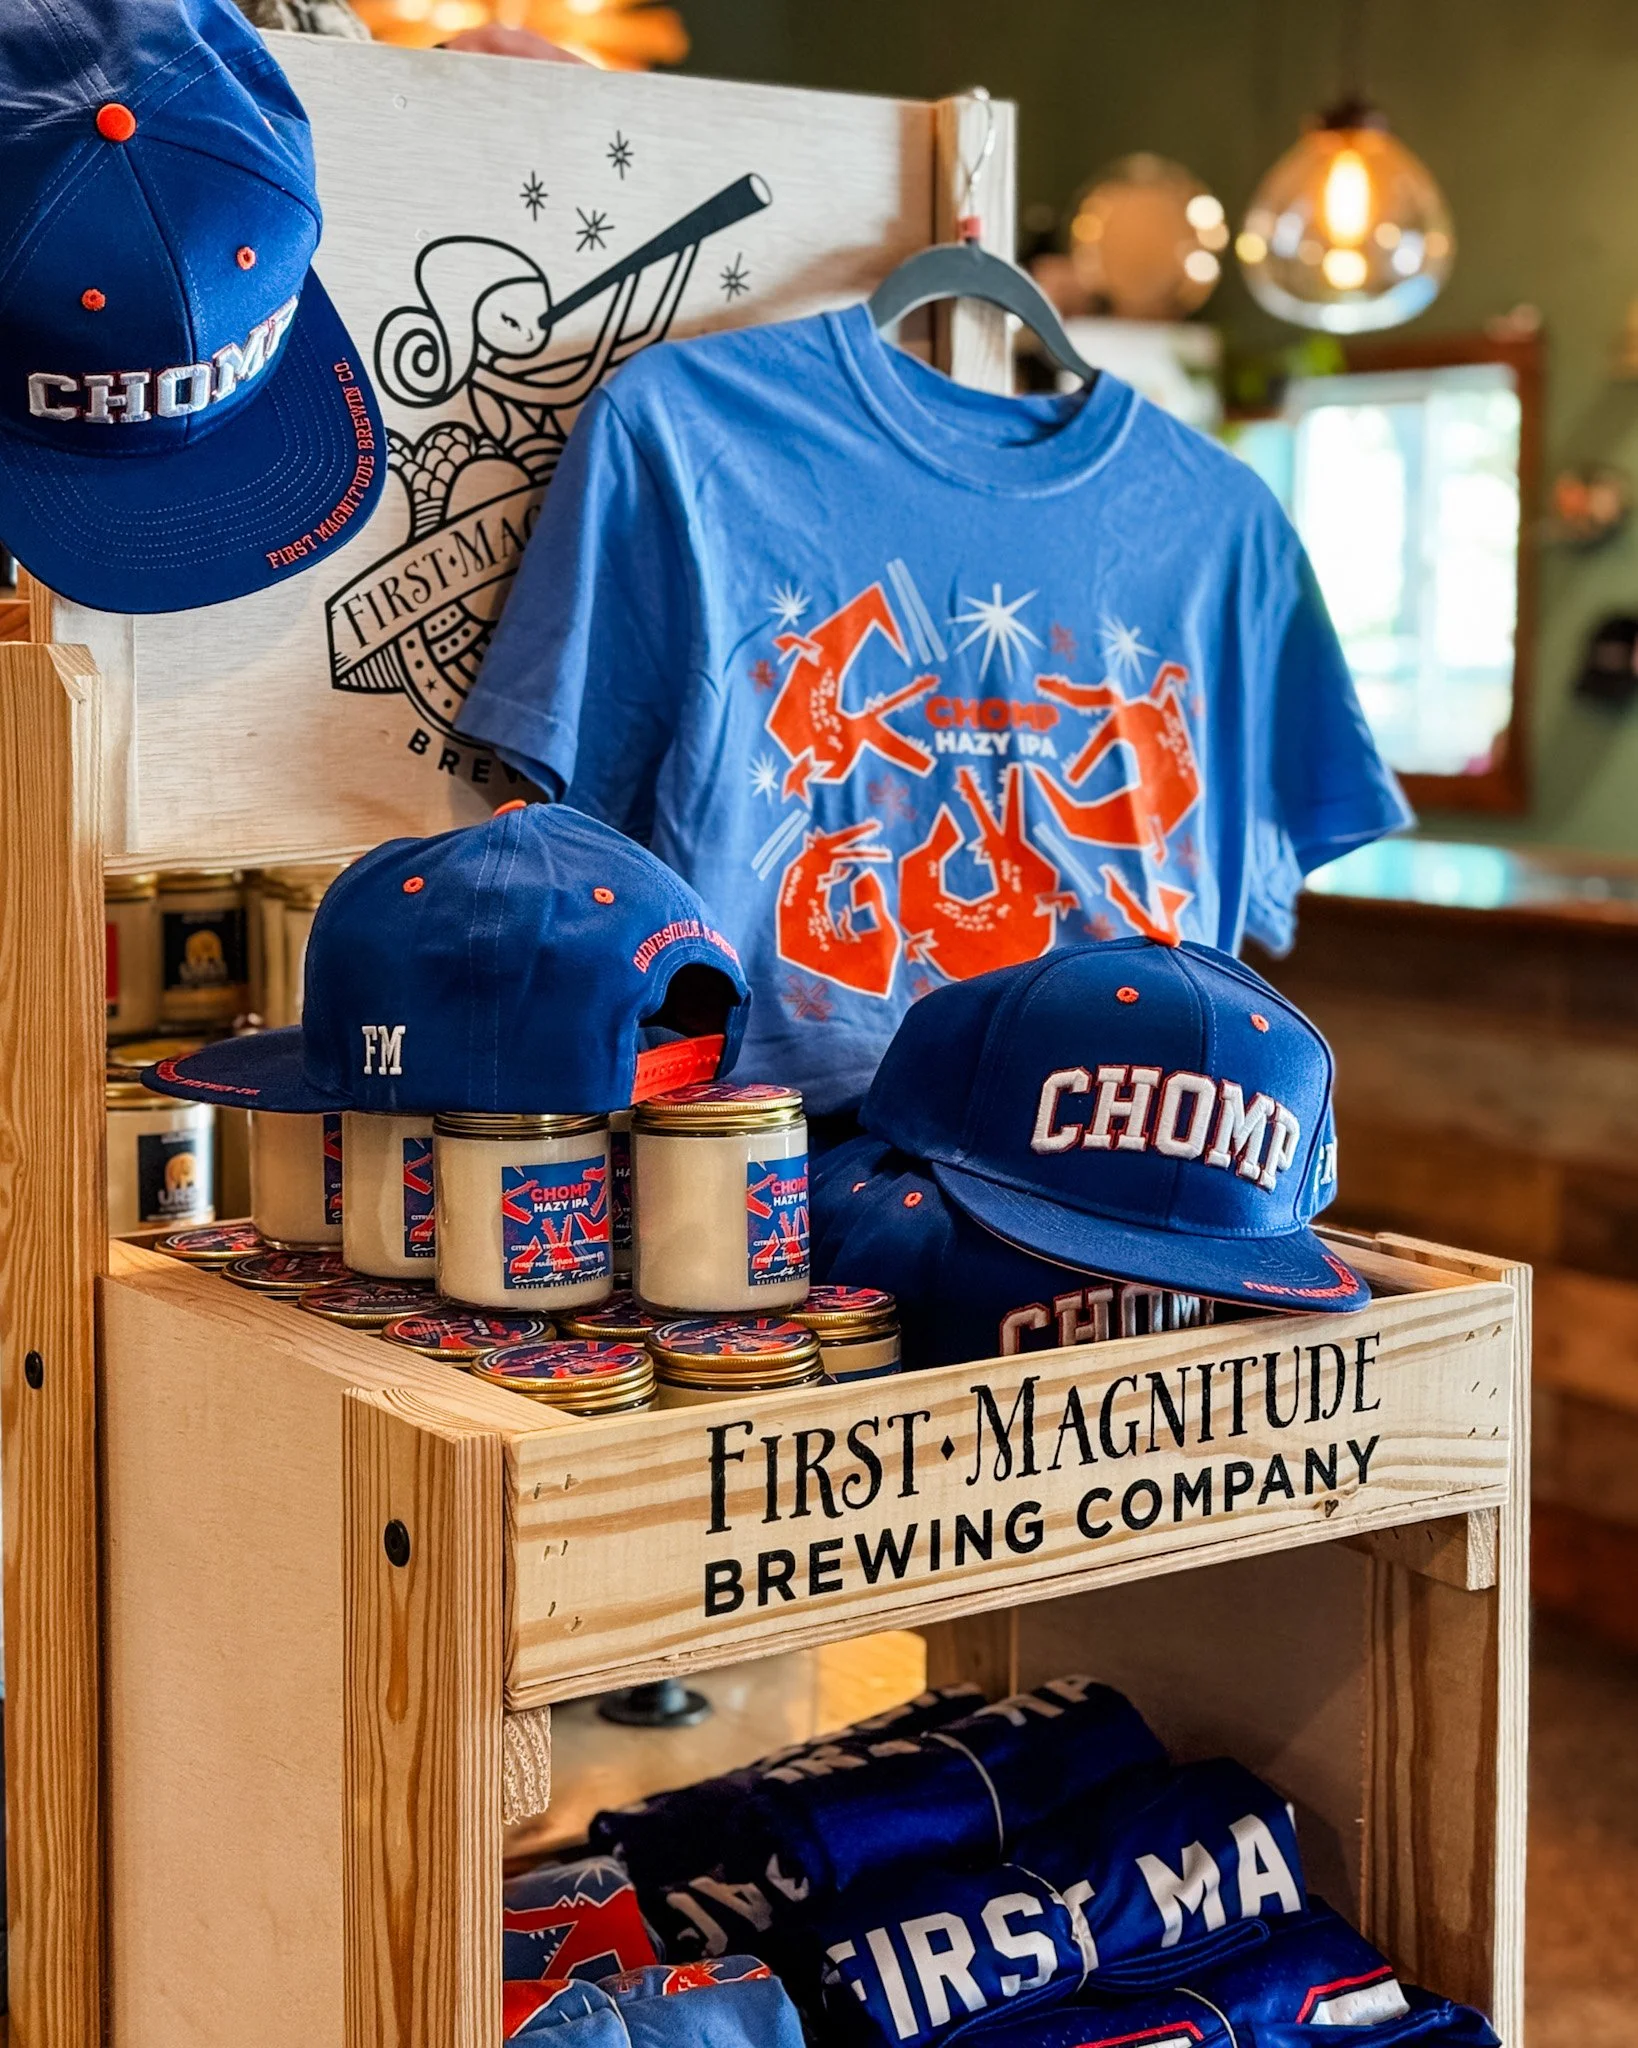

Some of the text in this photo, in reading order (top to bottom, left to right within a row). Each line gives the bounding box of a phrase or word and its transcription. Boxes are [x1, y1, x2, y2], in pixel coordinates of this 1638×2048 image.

[27, 295, 299, 425] CHOMP
[333, 356, 355, 383] CO.
[313, 455, 375, 543] MAGNITUDE
[266, 536, 318, 569] FIRST
[340, 547, 451, 648] FIRST
[925, 696, 1061, 733] CHOMP
[934, 730, 1058, 759] HAZY IPA
[362, 1025, 406, 1075] FM
[1030, 1064, 1302, 1195] CHOMP
[530, 1182, 592, 1202] CHOMP
[533, 1198, 590, 1213] HAZY IPA
[771, 1176, 808, 1196] CHOM
[773, 1194, 798, 1207] HAZY
[705, 1331, 1383, 1536] FIRST MAGNITUDE
[703, 1434, 1381, 1617] BREWING COMPANY
[1134, 1801, 1302, 1949] MA
